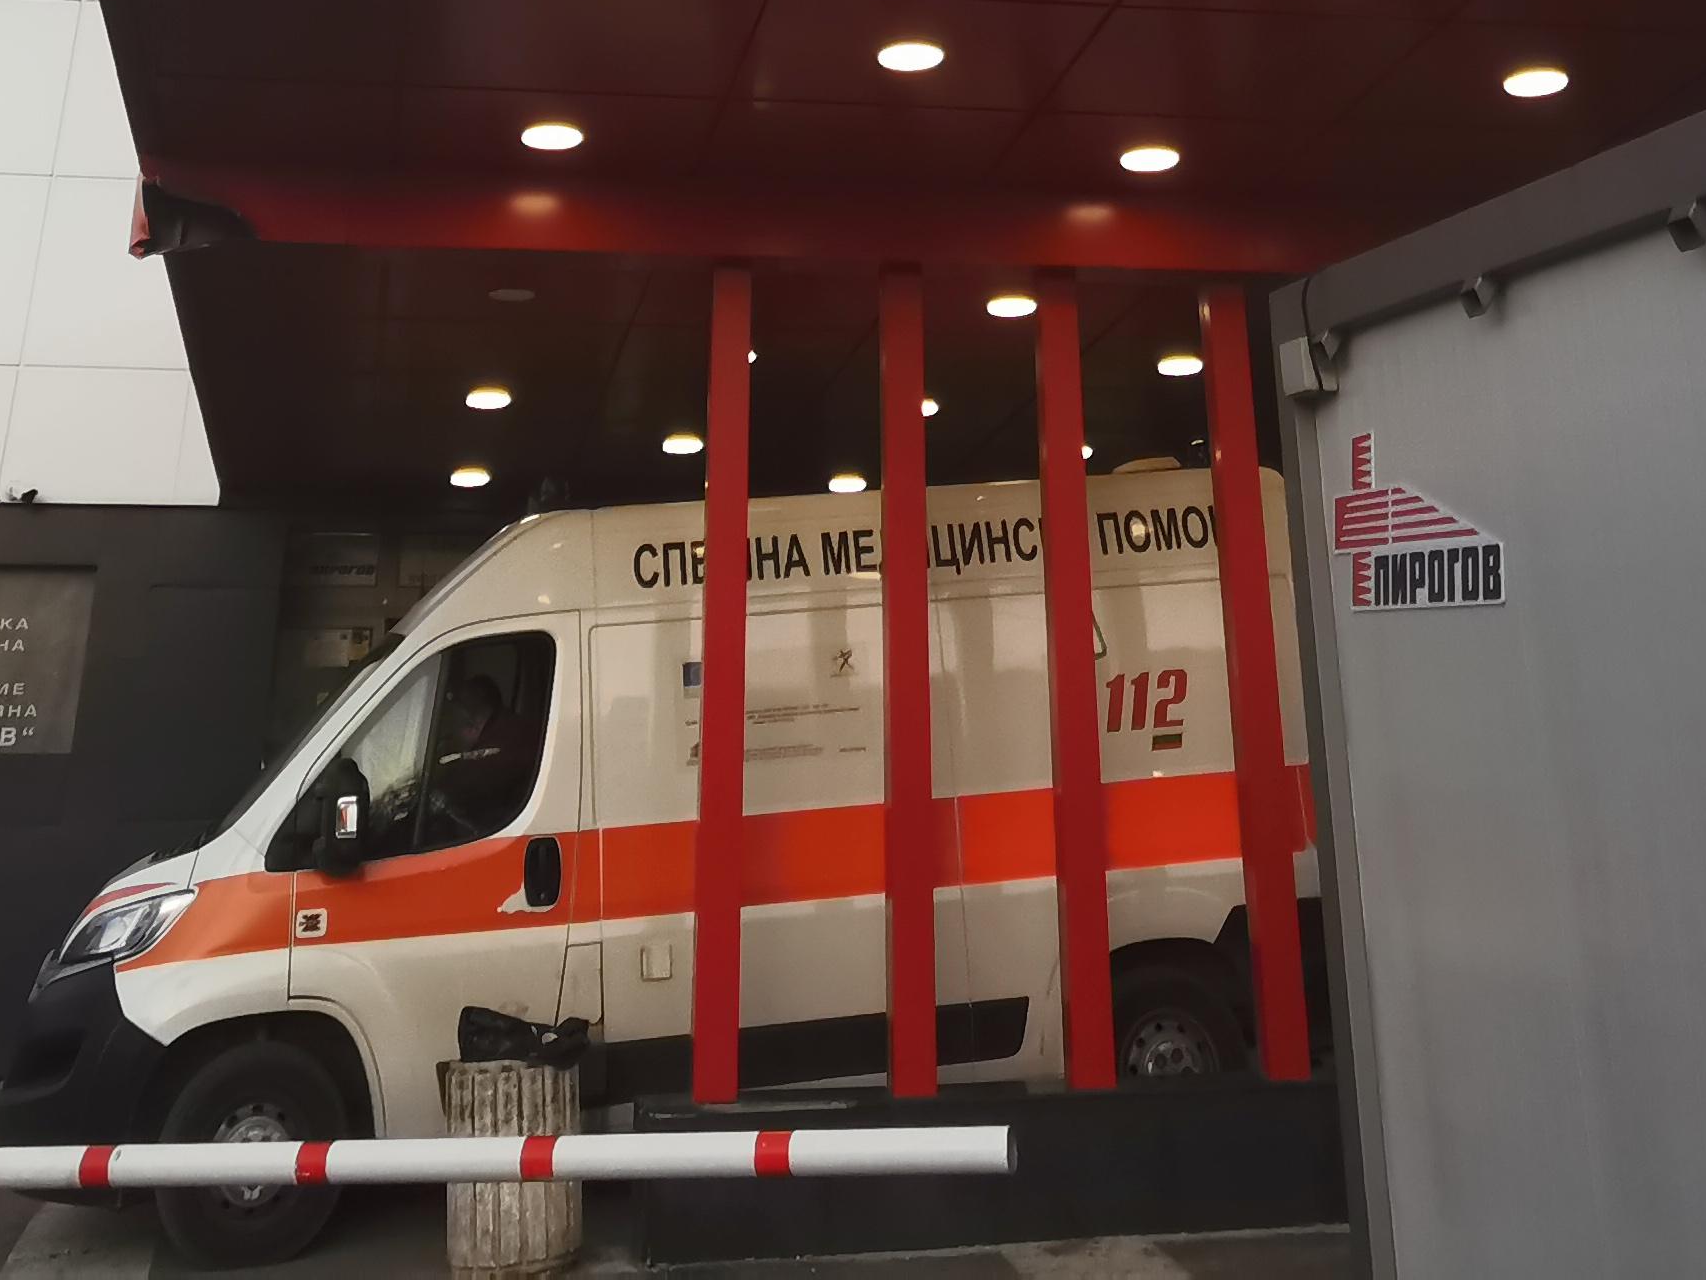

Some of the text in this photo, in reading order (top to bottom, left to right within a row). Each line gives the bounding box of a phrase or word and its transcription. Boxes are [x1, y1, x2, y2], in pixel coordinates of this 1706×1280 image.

[633, 533, 812, 589] СПЕНА
[1374, 543, 1503, 607] ПИРОГОВ
[1105, 668, 1188, 733] 112
